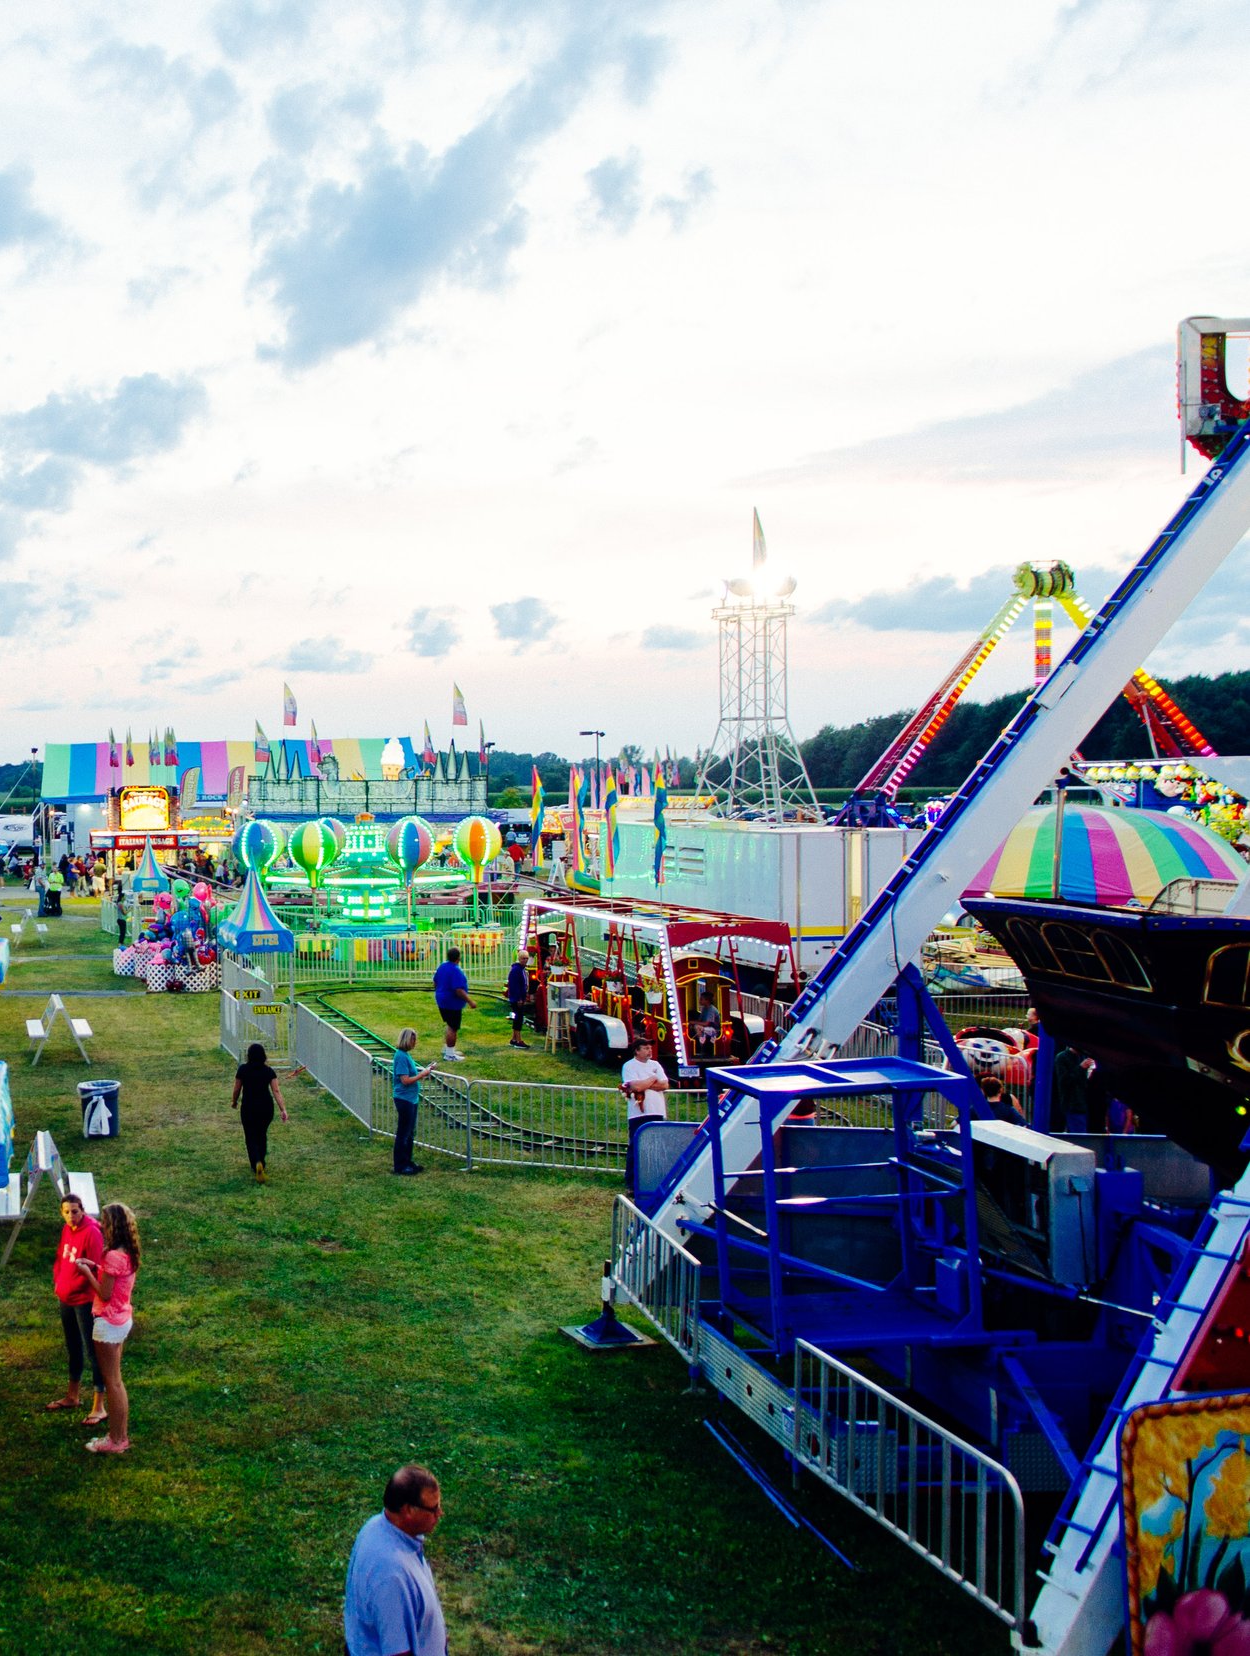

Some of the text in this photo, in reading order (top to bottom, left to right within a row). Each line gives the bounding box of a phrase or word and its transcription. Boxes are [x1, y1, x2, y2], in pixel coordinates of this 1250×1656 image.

[123, 796, 167, 812] SAUSAGE
[118, 838, 175, 846] ITALIAN AUSAGE
[252, 934, 278, 946] ENTER
[235, 990, 259, 998] EXIT
[254, 1005, 281, 1014] ENTRANCE
